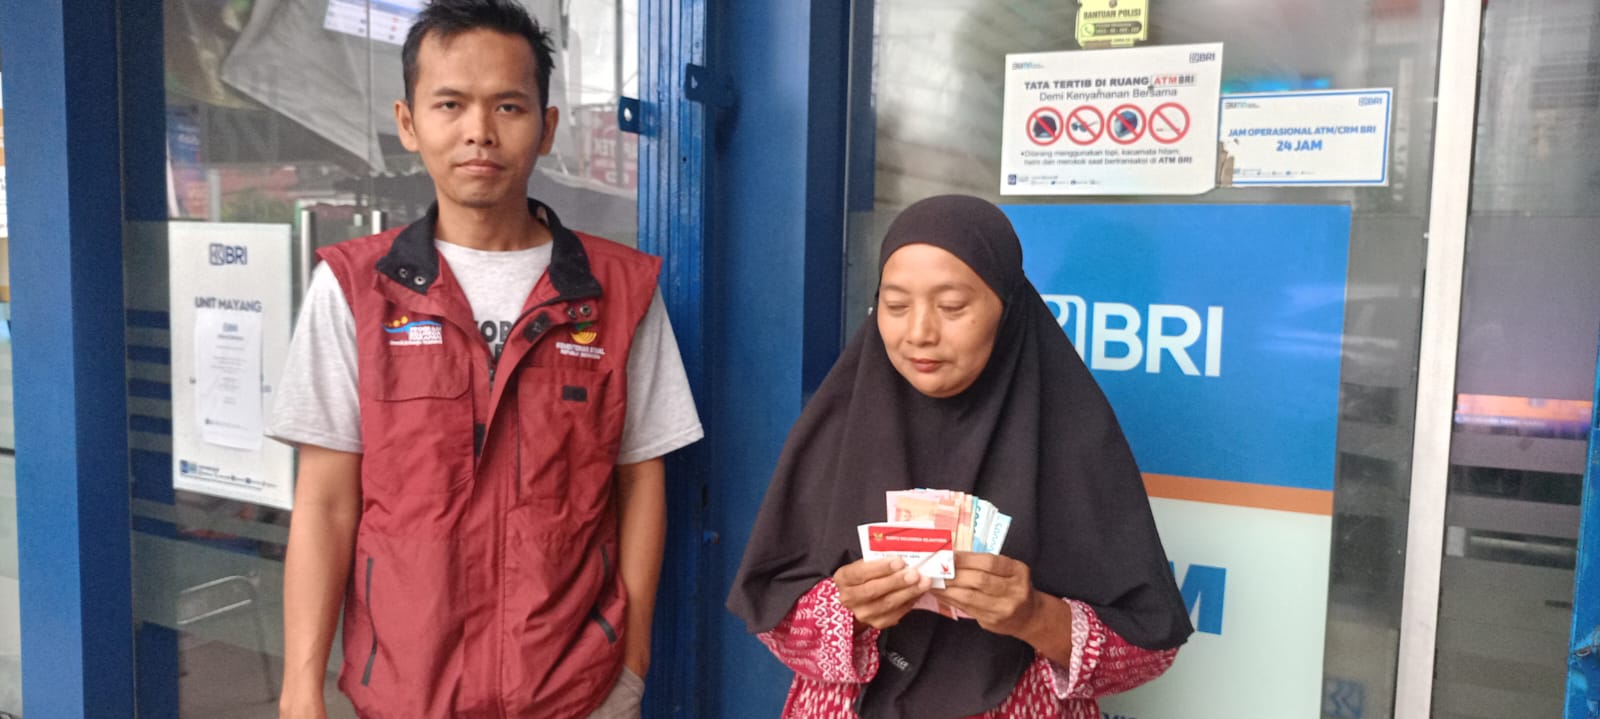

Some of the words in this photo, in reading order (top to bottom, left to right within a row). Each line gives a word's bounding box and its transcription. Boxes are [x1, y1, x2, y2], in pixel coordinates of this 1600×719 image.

[1084, 10, 1116, 19] BANTUAN
[1118, 8, 1141, 17] POLISI
[1024, 81, 1049, 90] TATA
[1053, 79, 1091, 89] TERTIB
[1095, 79, 1106, 88] DI
[1110, 77, 1149, 87] RUANG
[1040, 92, 1063, 101] Demi
[1067, 89, 1129, 102] Kenyamanan
[1133, 88, 1177, 98] Bersama
[1228, 128, 1246, 137] JAM
[1248, 126, 1312, 136] OPERASIONAL
[1314, 125, 1359, 135] ATM/CRM
[1360, 125, 1376, 134] BRI
[1276, 140, 1292, 151] 24
[1294, 139, 1323, 151] JAM
[1025, 150, 1052, 158] Dilarang
[1054, 150, 1103, 158] menggunakan
[1159, 156, 1175, 164] ATM
[1177, 156, 1192, 164] BRI
[225, 244, 248, 265] BRI
[195, 296, 216, 308] UNIT
[218, 299, 262, 313] MAYANG
[1091, 302, 1224, 377] BRI
